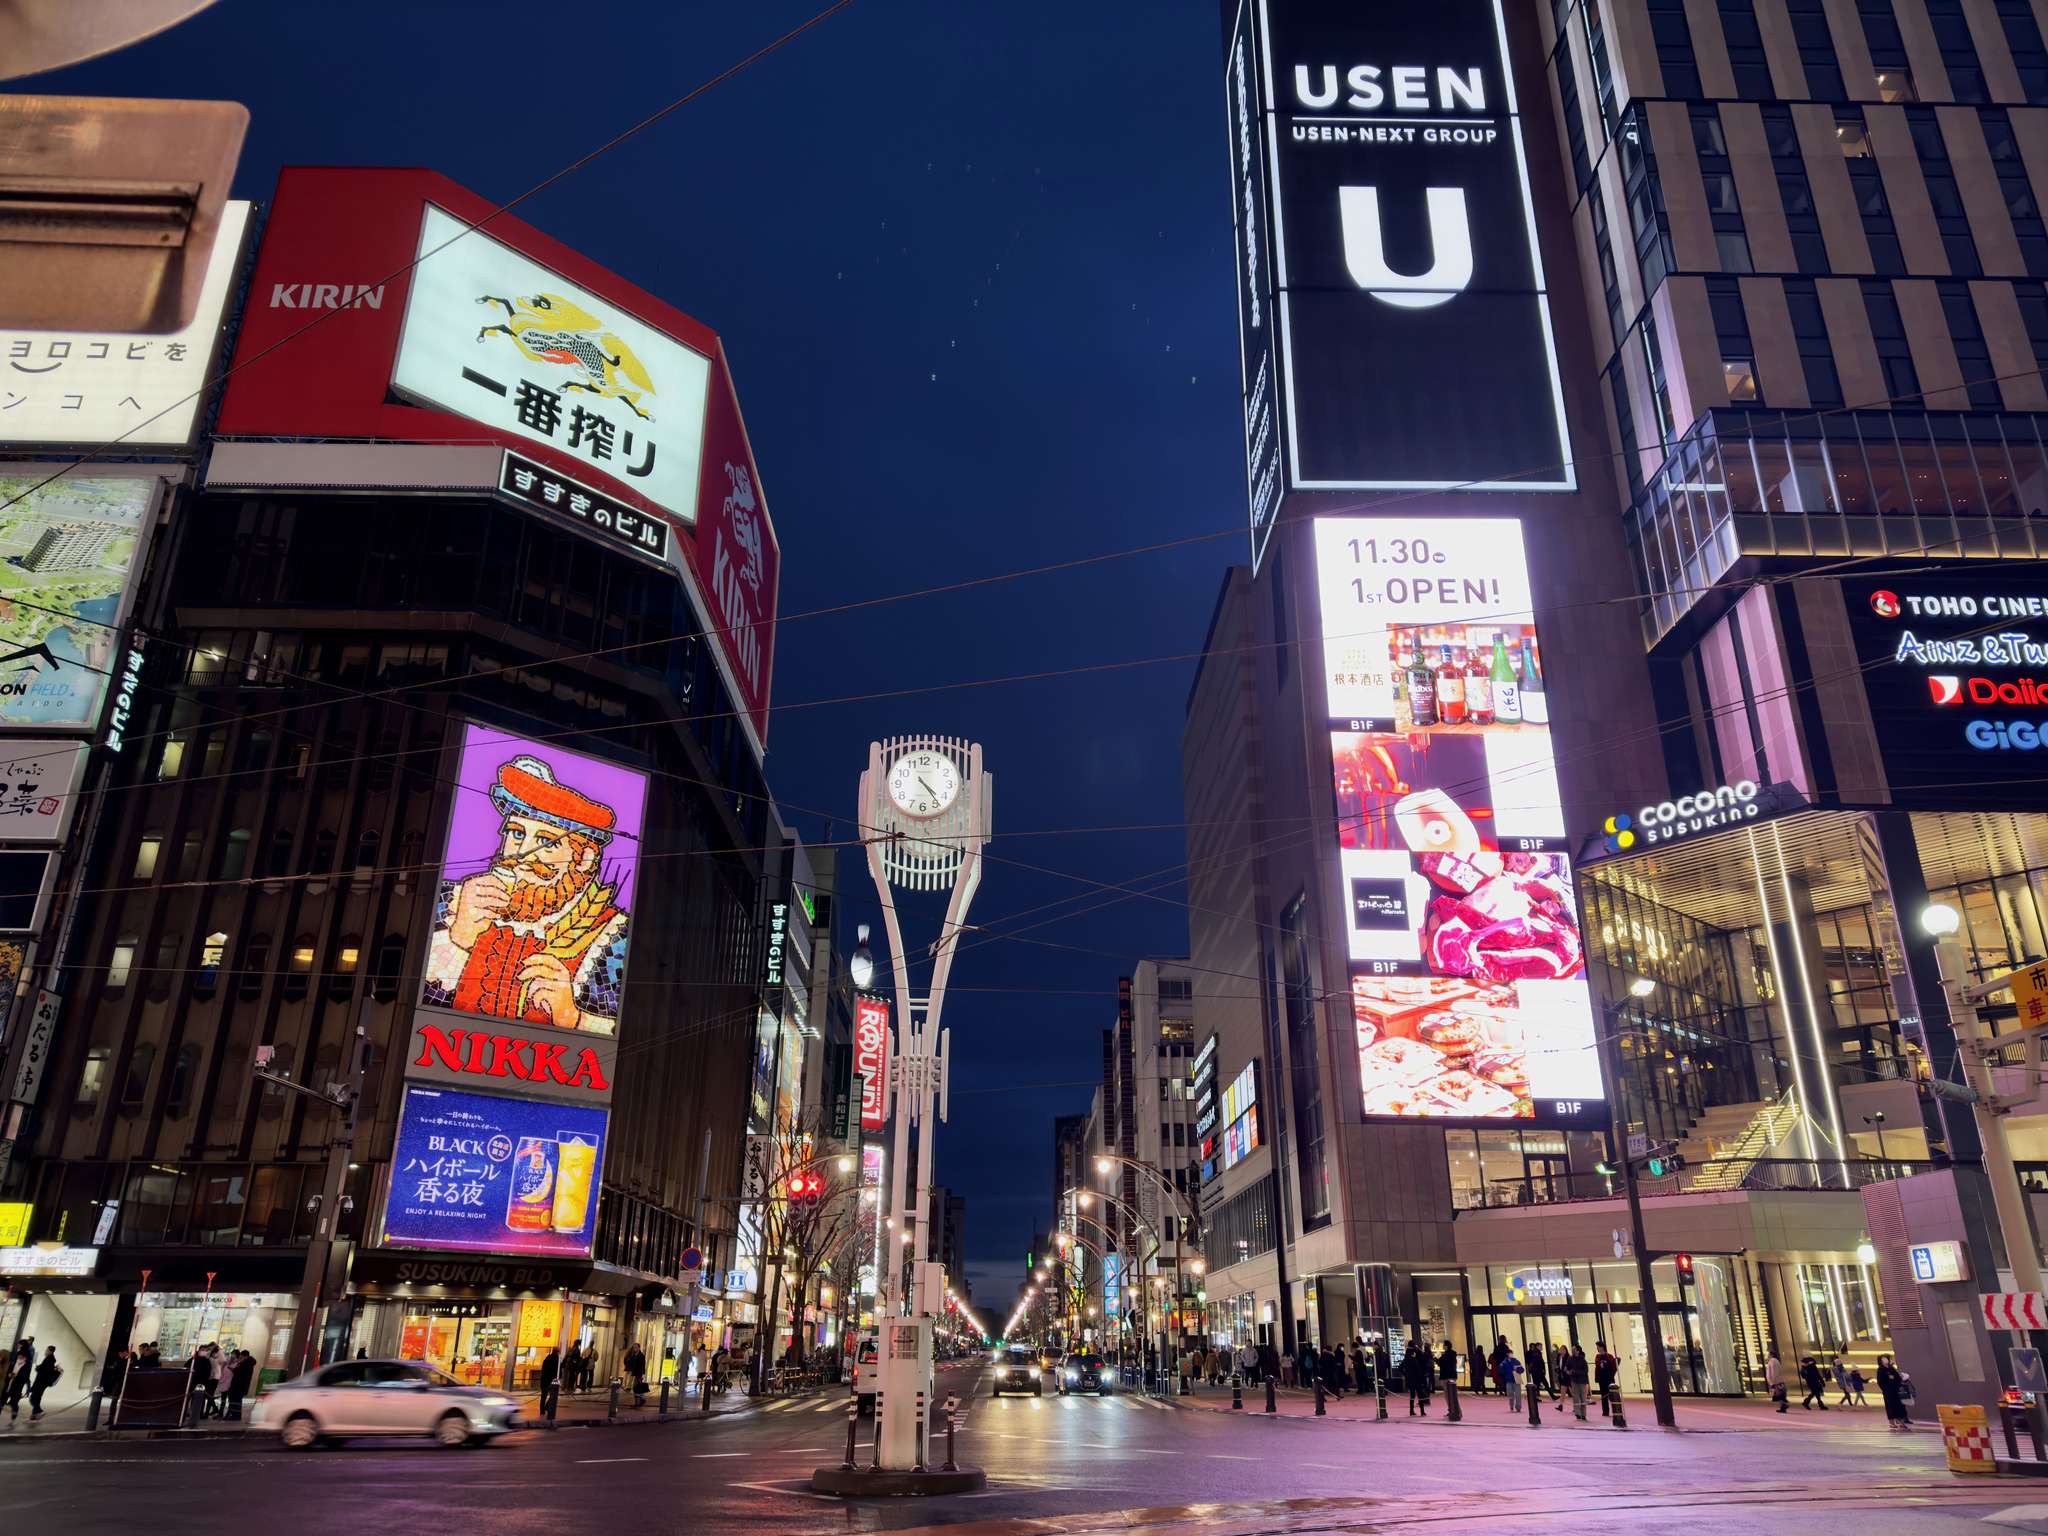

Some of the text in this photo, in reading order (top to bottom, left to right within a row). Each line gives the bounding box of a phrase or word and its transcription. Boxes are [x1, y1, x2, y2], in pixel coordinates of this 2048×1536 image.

[1294, 65, 1486, 109] USEN
[1292, 127, 1497, 144] USEN-NEXT GROUP
[1339, 186, 1474, 308] U
[269, 283, 385, 310] KIRIN
[9, 340, 188, 362] ヨロコビを
[461, 366, 657, 477] 一番搾り
[513, 466, 659, 548] すすきのビル
[1347, 538, 1430, 564] 11.30
[1386, 578, 1500, 604] OPEN!
[712, 527, 762, 700] KIRIN
[1906, 596, 1977, 615] TOHO
[1350, 720, 1374, 730] B1F
[907, 759, 917, 769] 11
[919, 756, 931, 766] 12
[894, 779, 953, 789] 9 3
[899, 768, 950, 778] 10 2
[898, 791, 948, 800] 8 4
[908, 799, 939, 812] 7 6 5
[1519, 839, 1545, 850] B1F
[766, 904, 787, 984] すすきのビル
[1373, 962, 1398, 973] B1F
[415, 1024, 609, 1090] NIKKA
[858, 1007, 881, 1120] ROUND1
[1556, 1103, 1582, 1114] B1F
[428, 1135, 485, 1156] BLACK
[404, 1156, 502, 1181] ハイボール
[413, 1177, 485, 1206] 香る夜
[405, 1207, 487, 1220] ENJOY A RELAXING NIGHT
[397, 1261, 508, 1284] SUSUKINO
